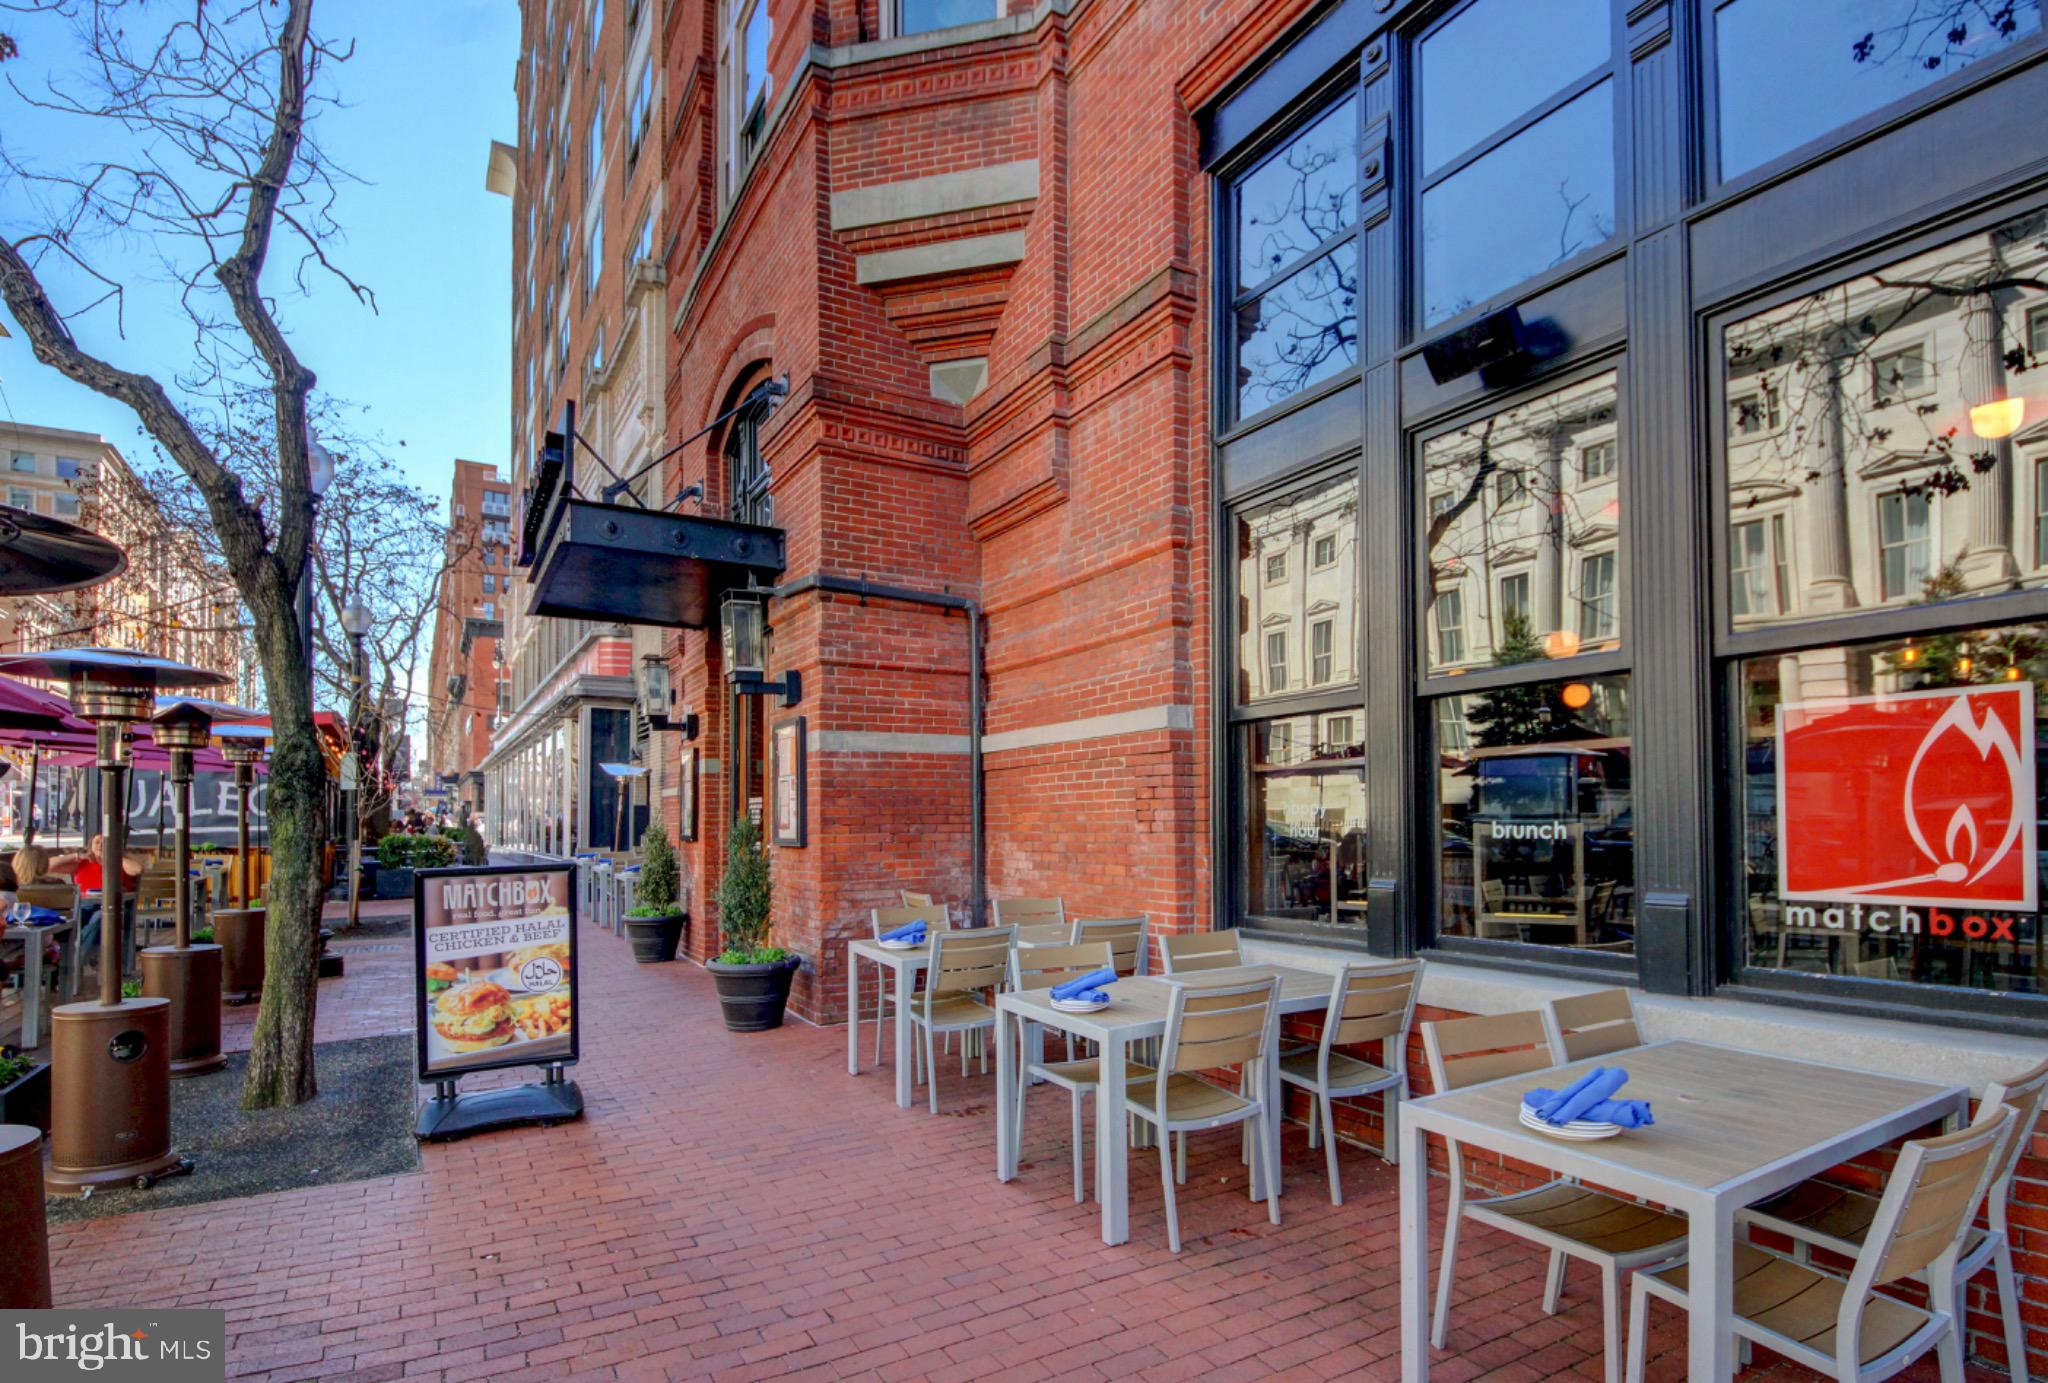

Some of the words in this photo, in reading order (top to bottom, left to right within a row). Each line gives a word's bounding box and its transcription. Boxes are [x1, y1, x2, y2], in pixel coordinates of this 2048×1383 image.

[1491, 820, 1567, 840] brunch
[443, 880, 550, 909] MATCHBOX
[428, 926, 511, 943] CERTIFIED
[515, 919, 565, 933] HALAL
[1785, 902, 2014, 941] matchbox
[434, 936, 506, 952] CHICKEN
[509, 935, 520, 944] &
[523, 929, 561, 941] BEEF
